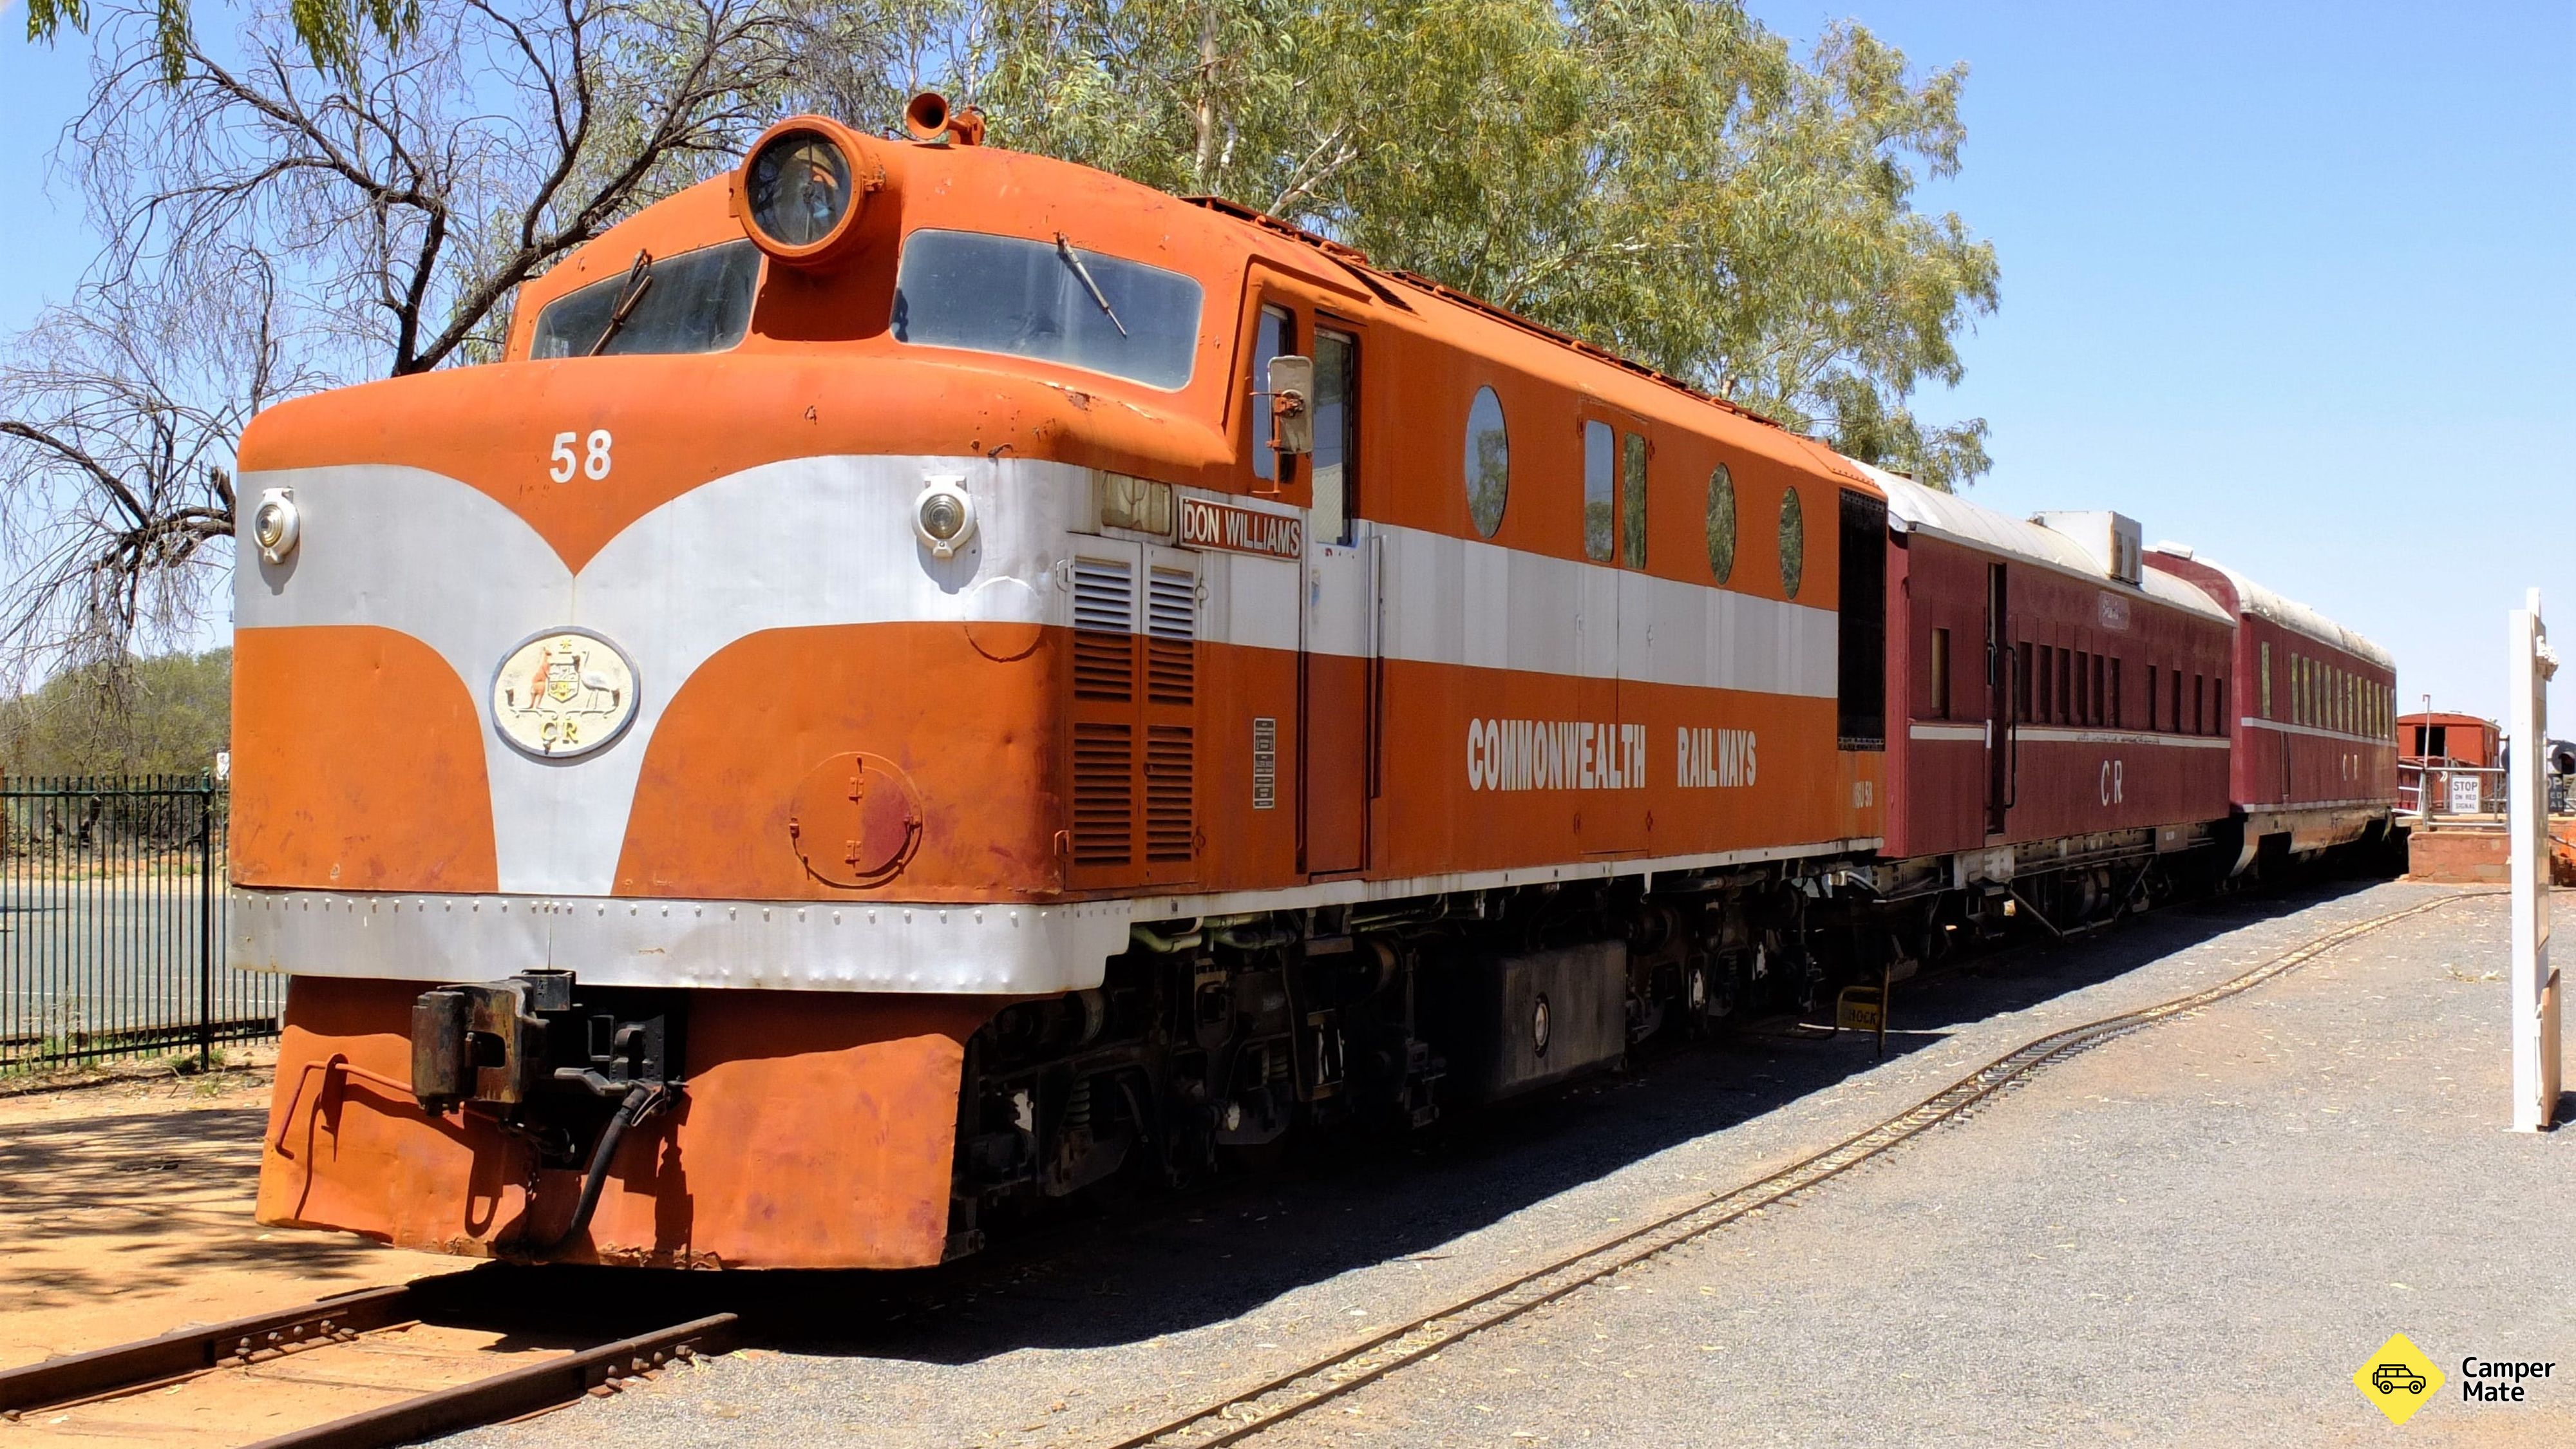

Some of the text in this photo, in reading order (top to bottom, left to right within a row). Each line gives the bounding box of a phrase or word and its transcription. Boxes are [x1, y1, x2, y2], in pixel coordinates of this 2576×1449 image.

[550, 429, 612, 483] 58
[1184, 503, 1300, 556] DON WILLIAMS
[540, 721, 579, 744] CR
[1468, 718, 1756, 791] COMMONWEALTH RAILWAYS
[2454, 781, 2477, 791] STOP
